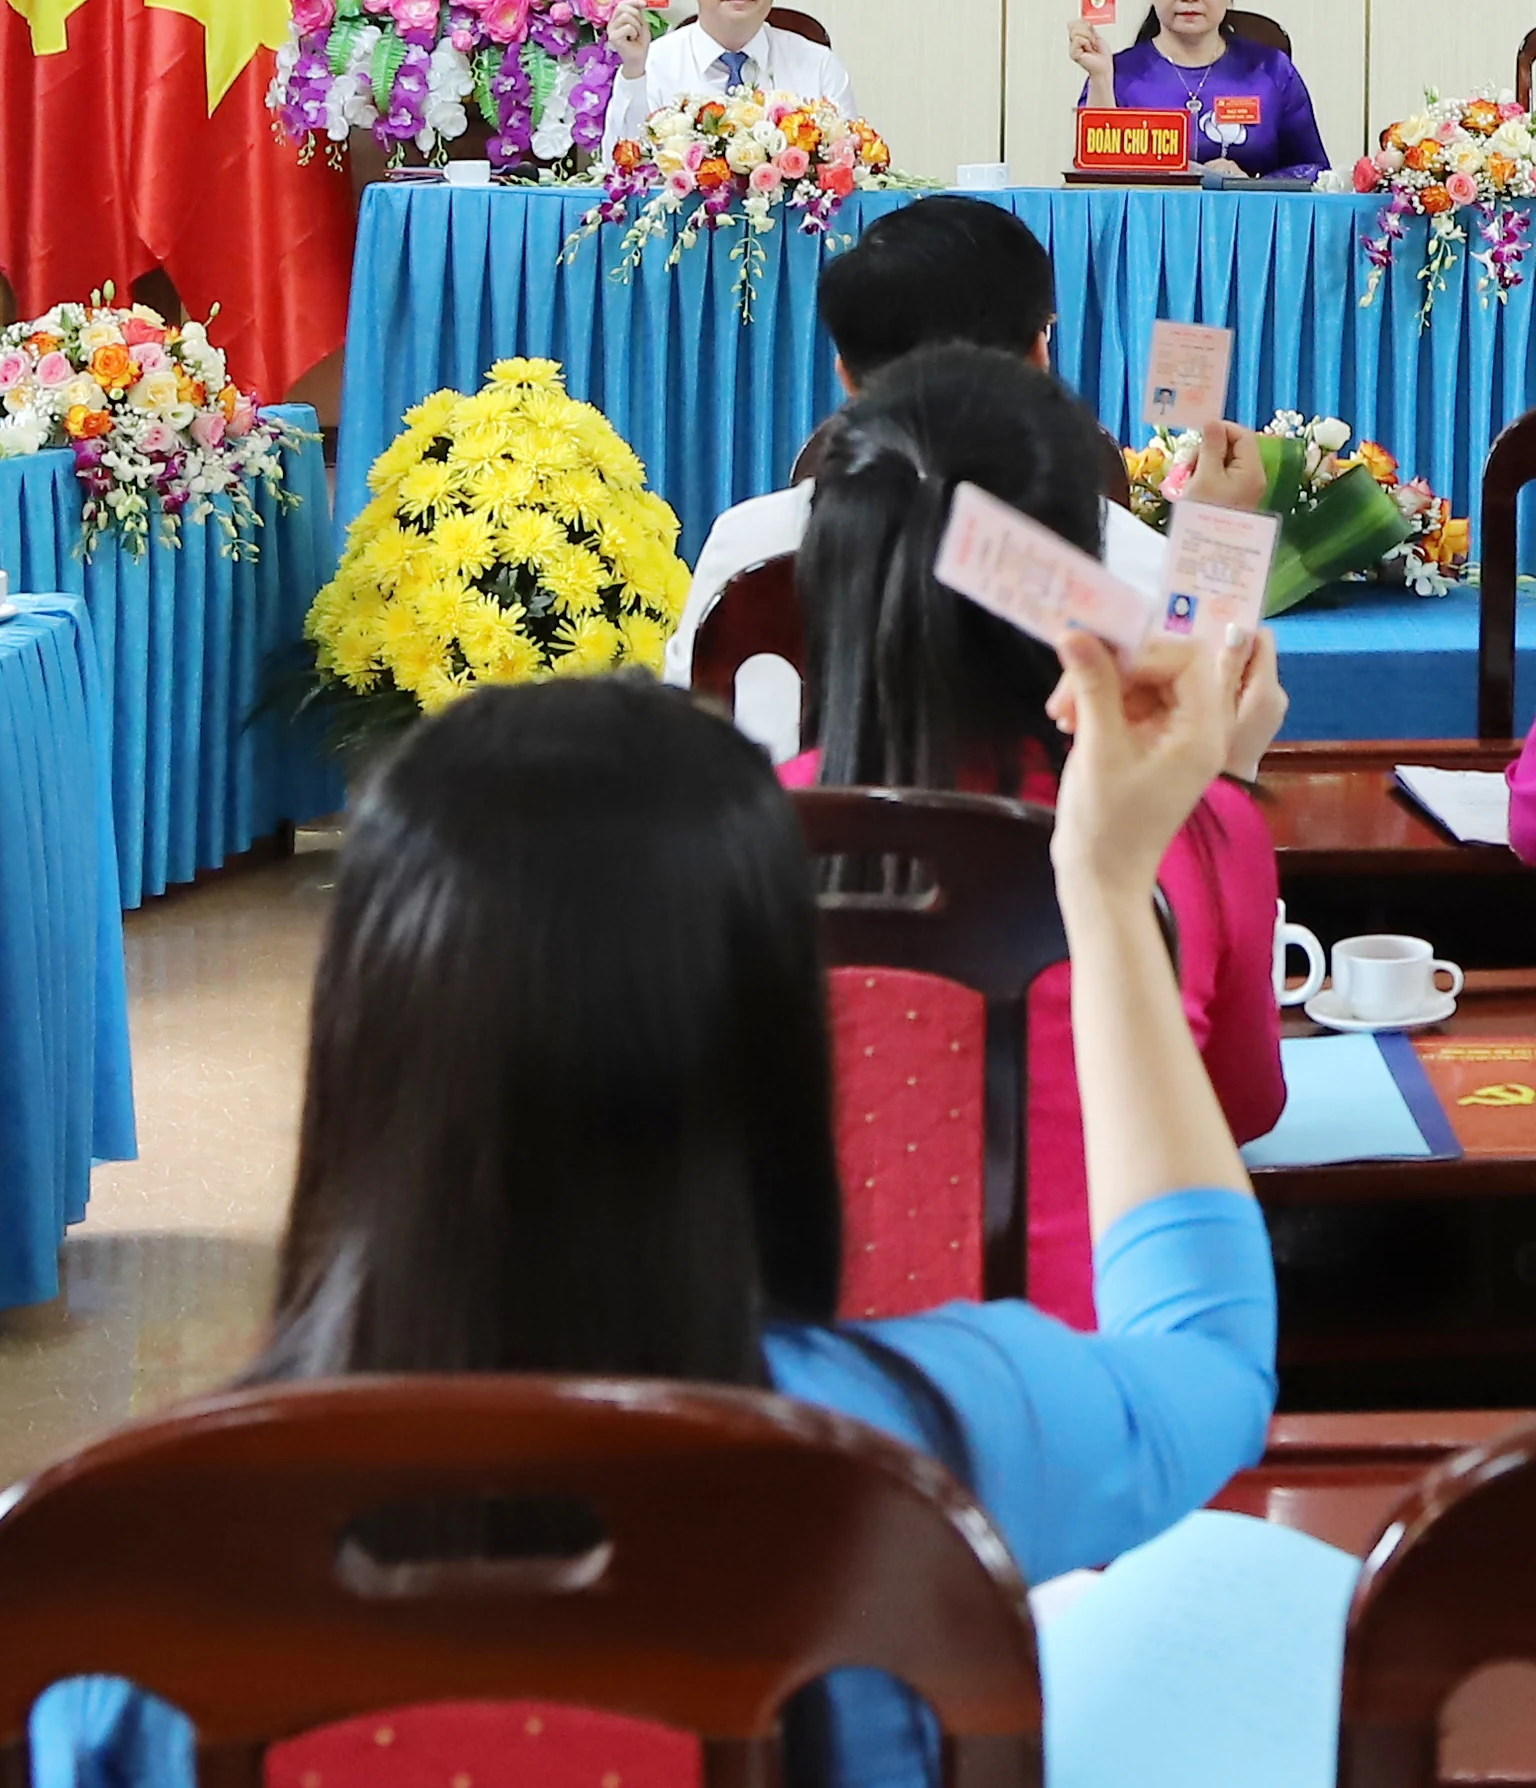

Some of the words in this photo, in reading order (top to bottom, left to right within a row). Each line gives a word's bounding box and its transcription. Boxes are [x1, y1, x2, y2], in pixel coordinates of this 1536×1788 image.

[1086, 122, 1121, 154] ĐOÀN
[1123, 119, 1149, 155] CHỦ
[1151, 129, 1179, 161] TỊCH
